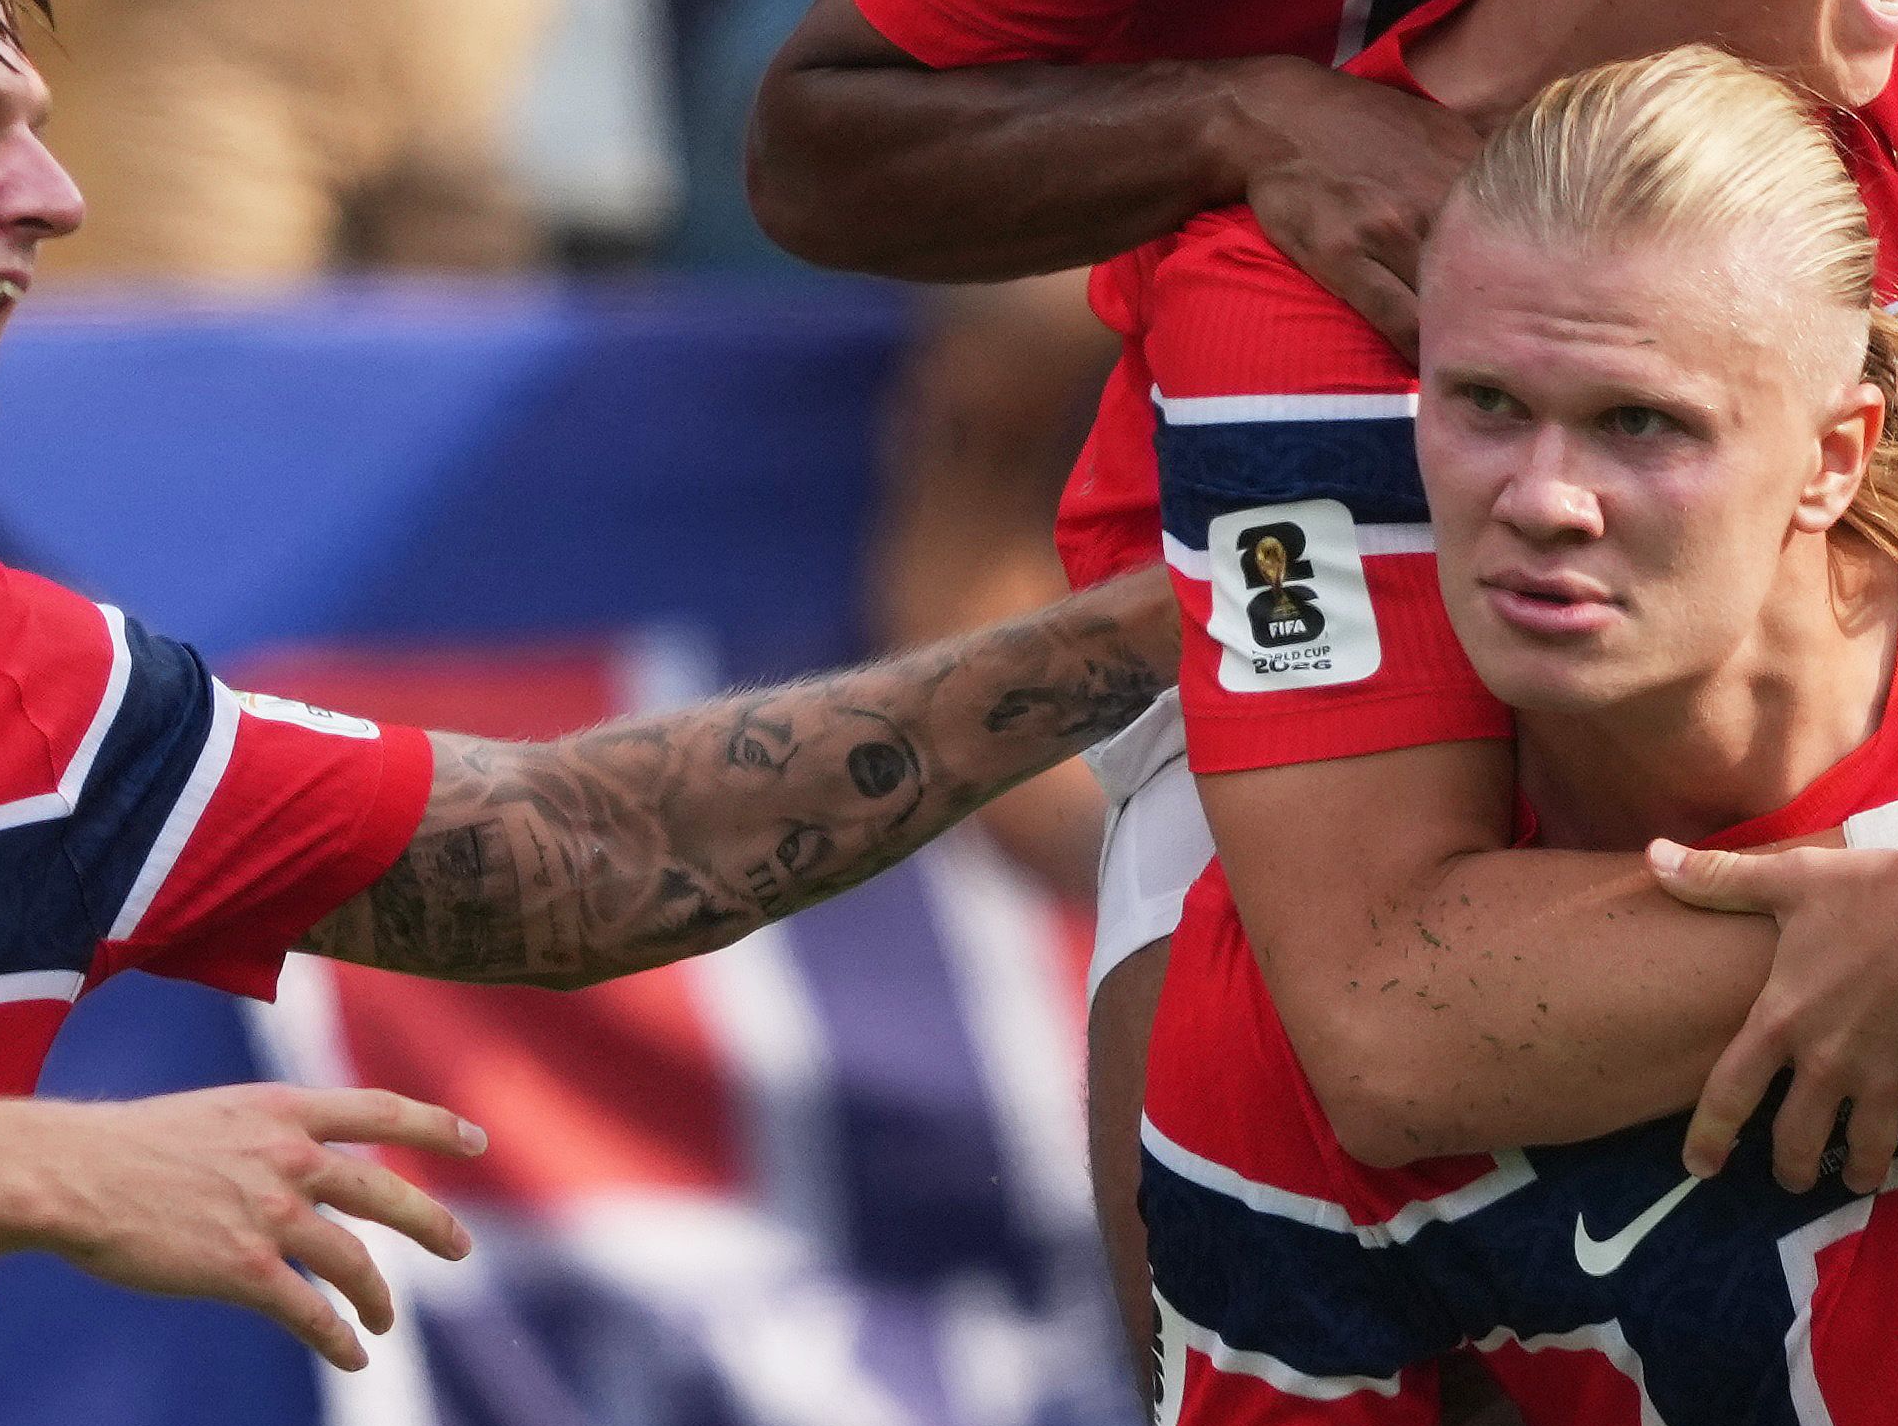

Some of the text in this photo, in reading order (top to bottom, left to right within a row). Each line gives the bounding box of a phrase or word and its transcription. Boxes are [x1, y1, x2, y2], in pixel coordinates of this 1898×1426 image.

[1268, 618, 1308, 640] FIFA
[1304, 645, 1331, 658] CUP
[1252, 657, 1332, 674] 2026
